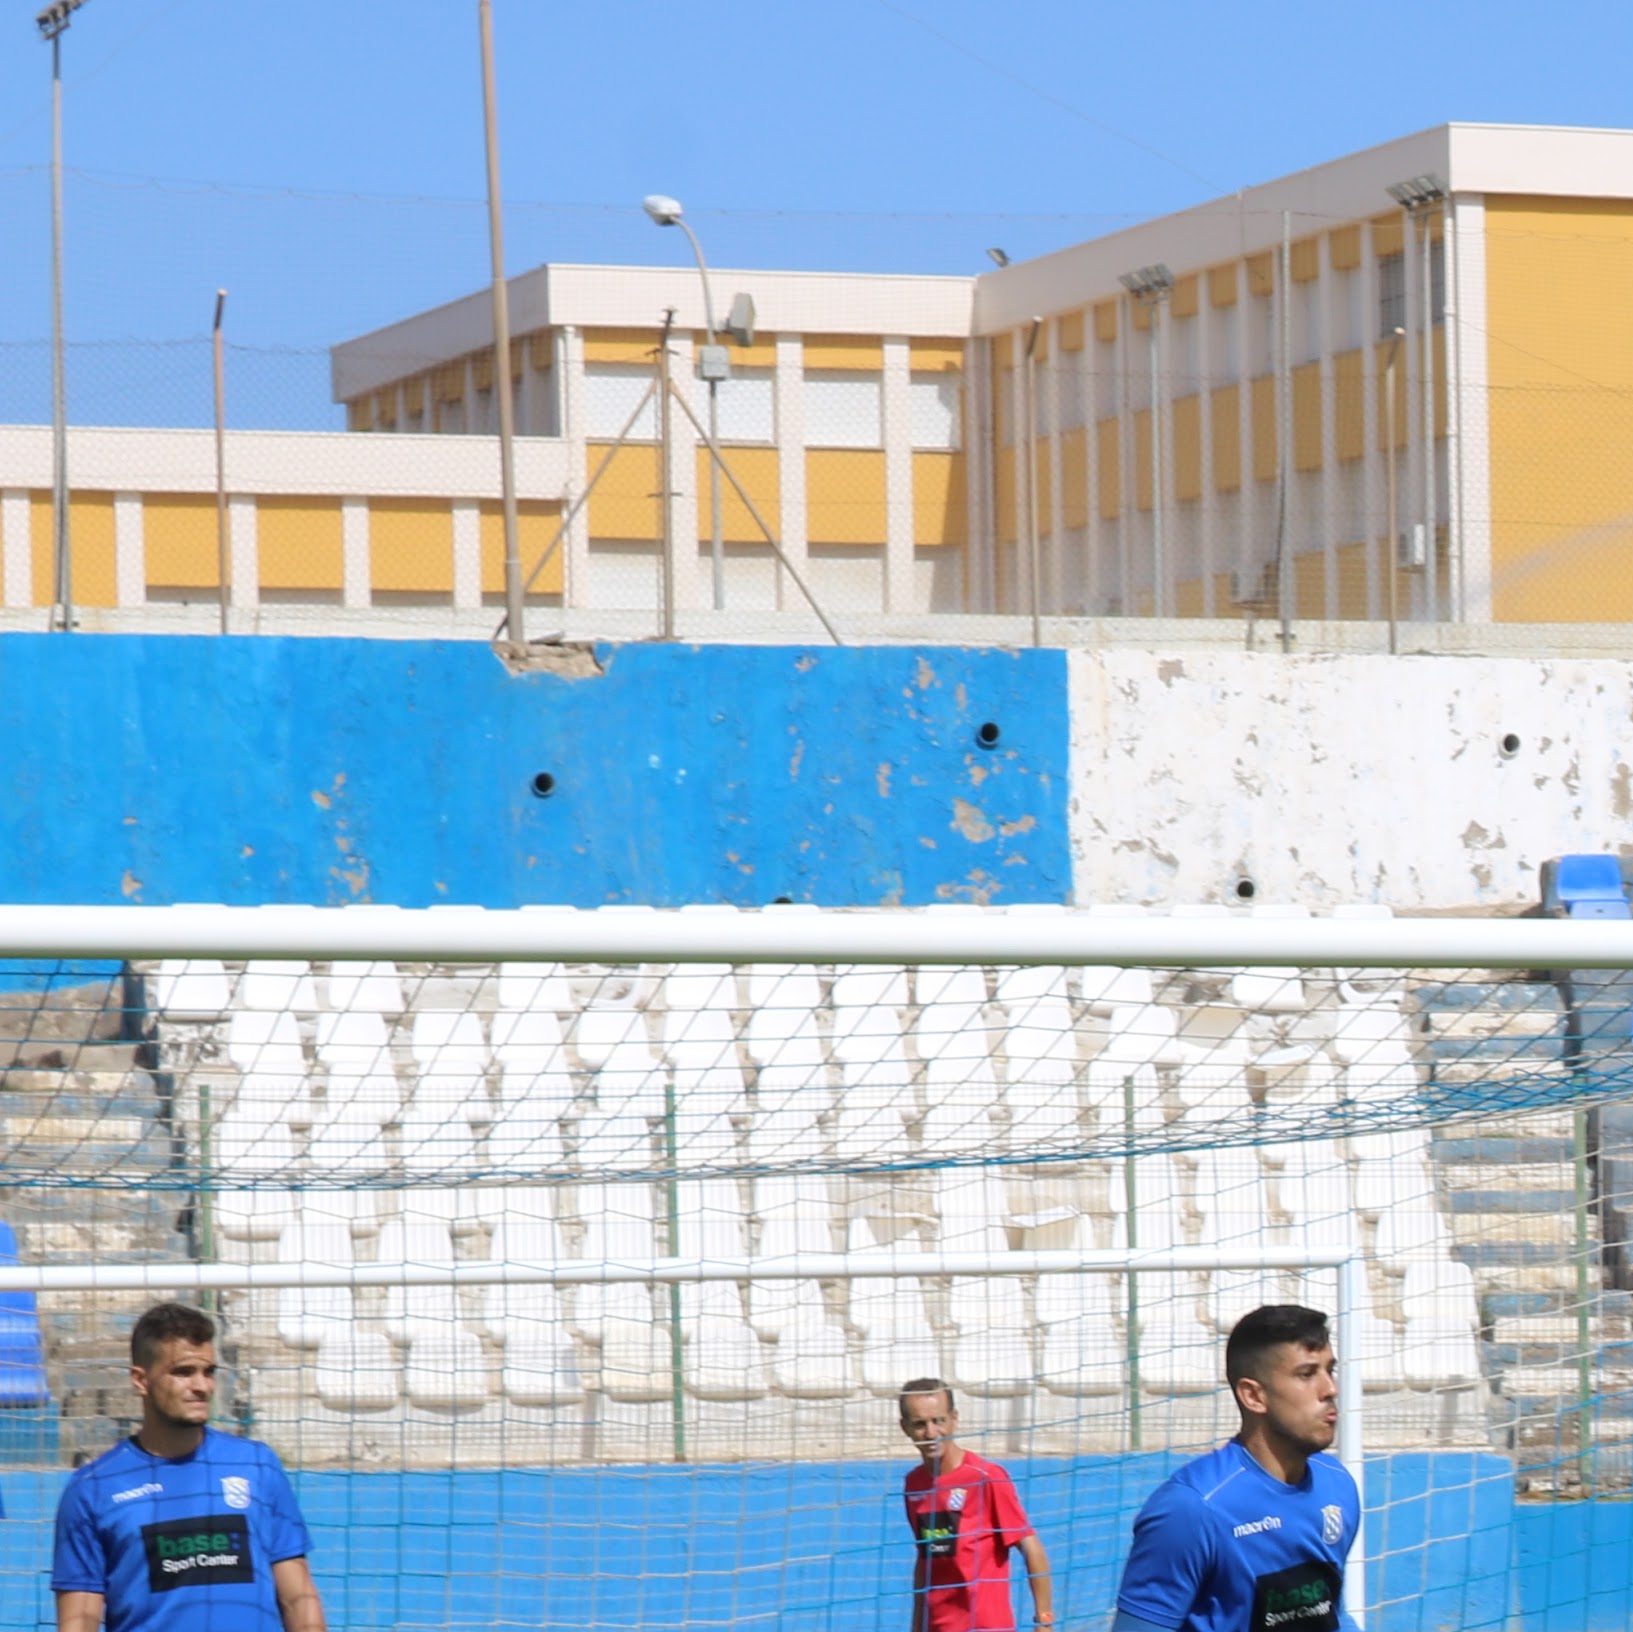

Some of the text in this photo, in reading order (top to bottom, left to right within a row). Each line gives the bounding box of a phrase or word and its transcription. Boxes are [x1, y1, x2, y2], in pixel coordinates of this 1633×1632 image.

[1233, 1516, 1282, 1538] macron
[162, 1553, 239, 1573] Sport Center
[1265, 1600, 1332, 1626] Sport Center
